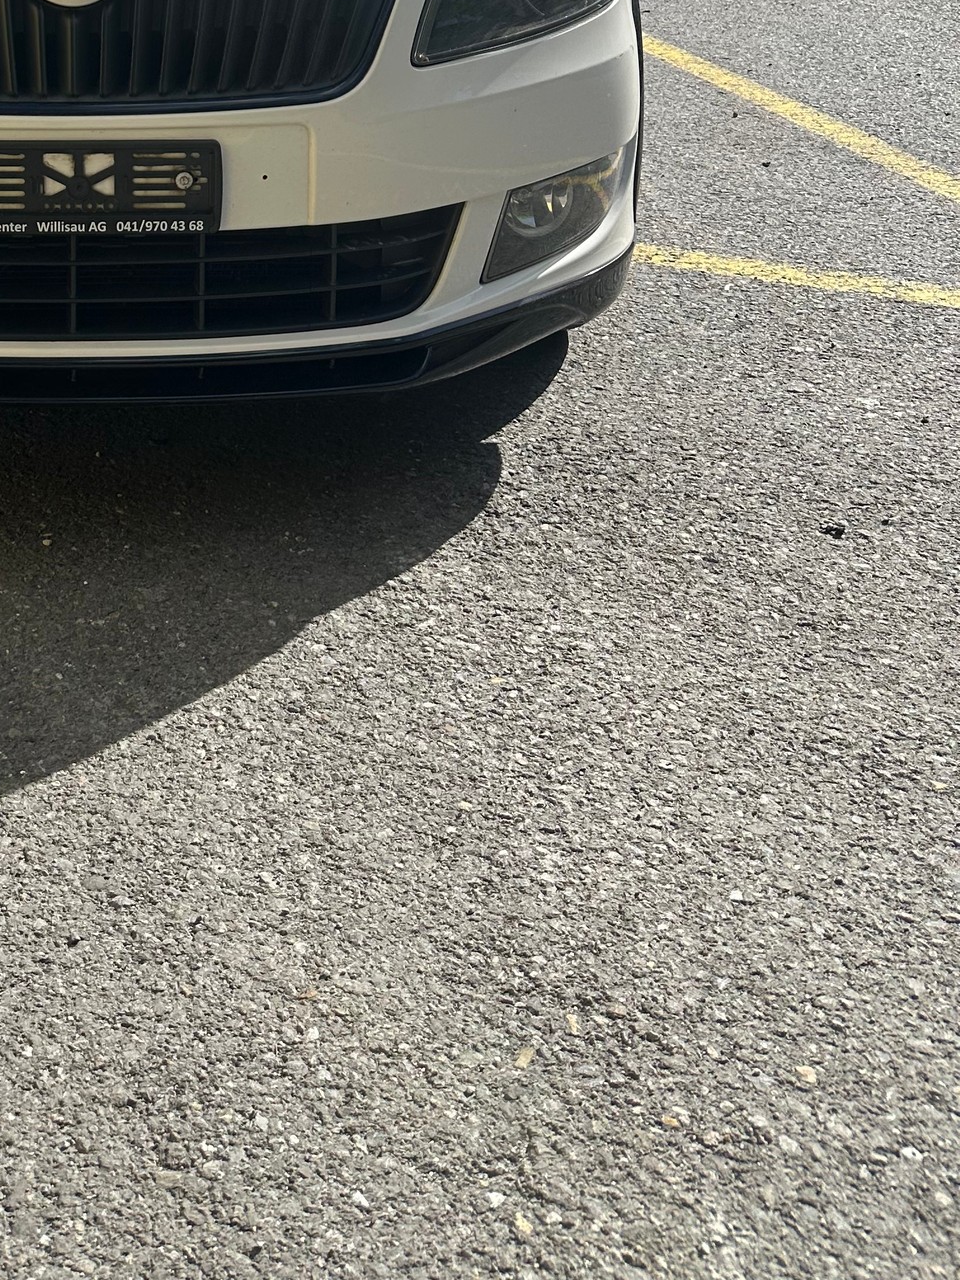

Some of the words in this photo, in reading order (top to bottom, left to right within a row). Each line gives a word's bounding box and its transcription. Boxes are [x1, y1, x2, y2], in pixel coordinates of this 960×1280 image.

[36, 221, 86, 233] Willisau
[88, 221, 107, 233] AG
[116, 219, 168, 233] 041/970
[170, 220, 186, 232] 43
[188, 220, 204, 232] 68
